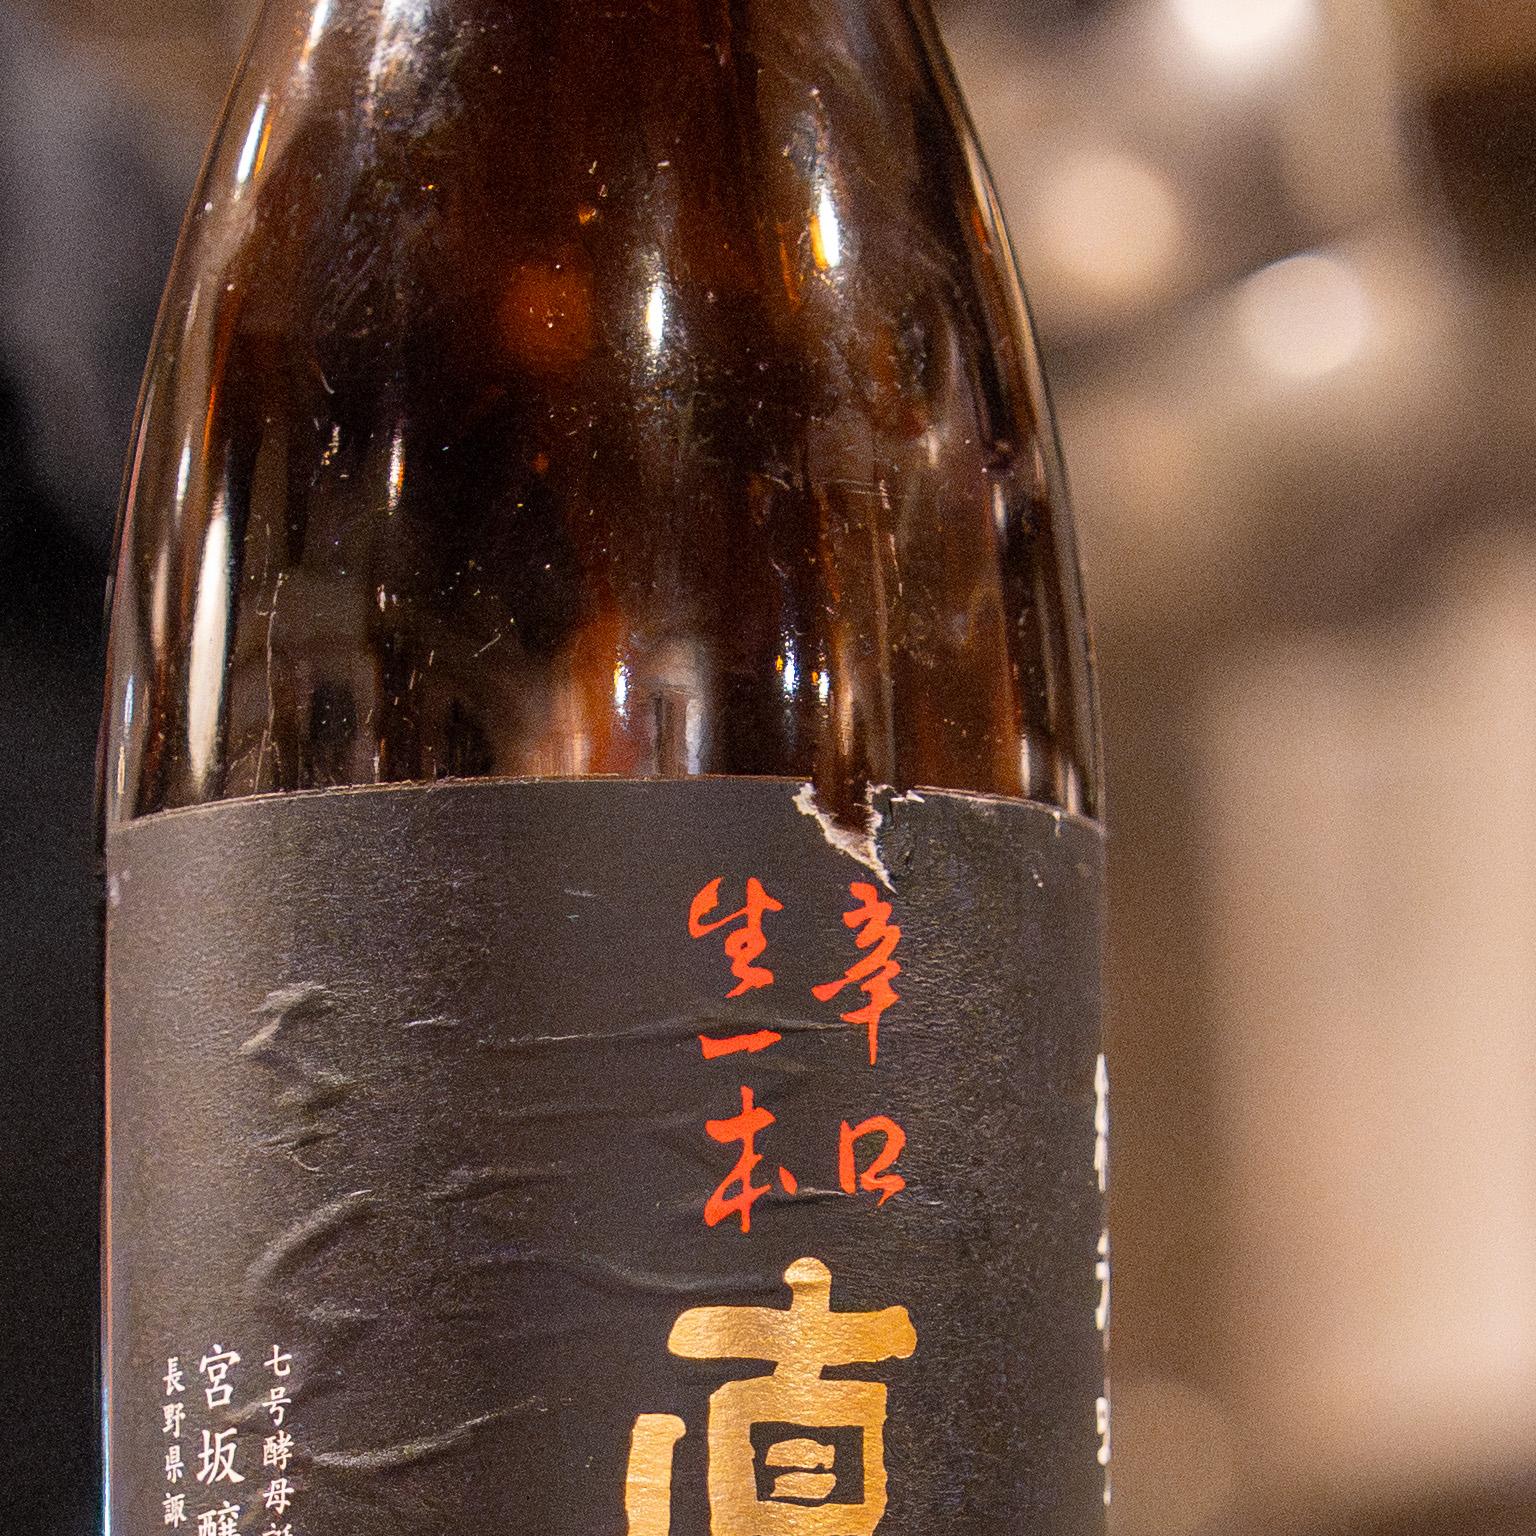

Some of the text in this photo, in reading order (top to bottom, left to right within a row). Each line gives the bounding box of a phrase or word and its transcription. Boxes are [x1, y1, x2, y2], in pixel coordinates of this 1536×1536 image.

[688, 876, 798, 1233] 生一本
[811, 881, 907, 1206] 辛口
